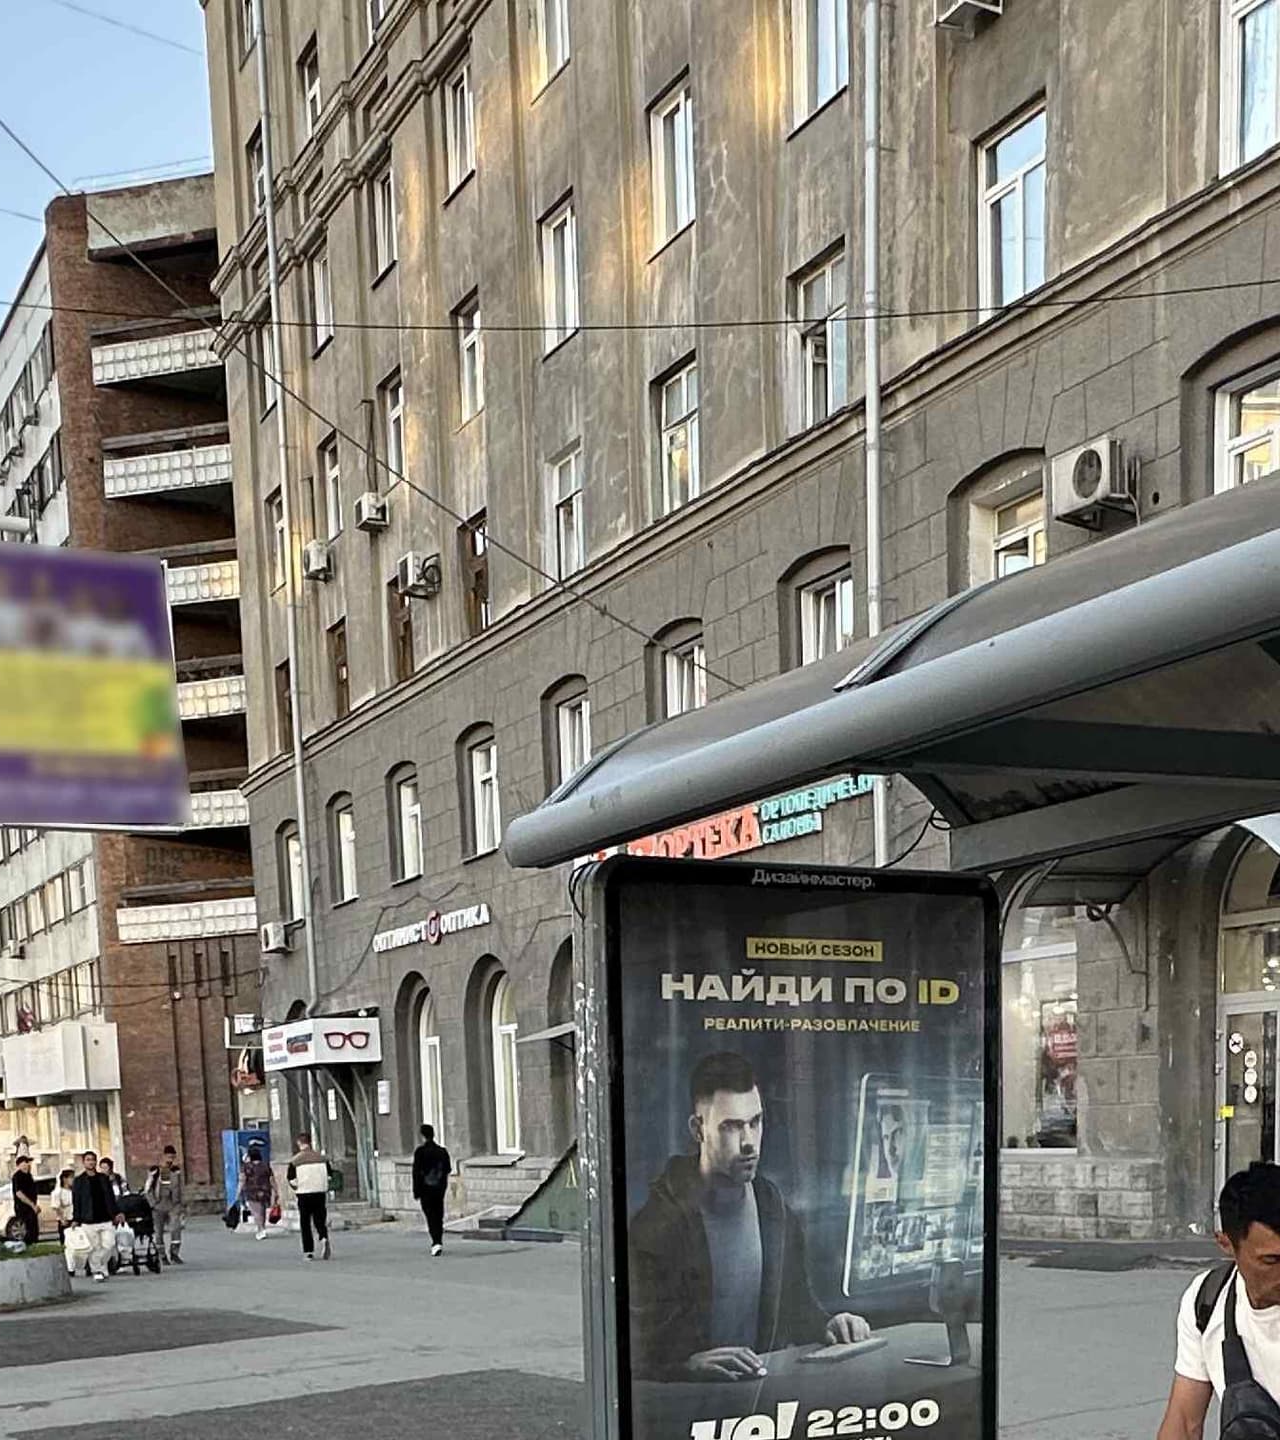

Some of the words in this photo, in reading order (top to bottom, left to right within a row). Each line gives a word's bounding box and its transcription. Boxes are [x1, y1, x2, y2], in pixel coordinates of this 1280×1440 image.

[440, 903, 490, 935] ОПТИКА
[755, 941, 817, 955] НОВЫЙ
[821, 944, 874, 957] СЕЗОН
[661, 969, 832, 1006] НАЙДИ
[844, 977, 907, 1004] ПО
[919, 979, 960, 1005] ID
[704, 1017, 921, 1032] РЕАЛИТИ-РАЗОБЛАЧЕНИЕ
[807, 1399, 940, 1438] 22:00
